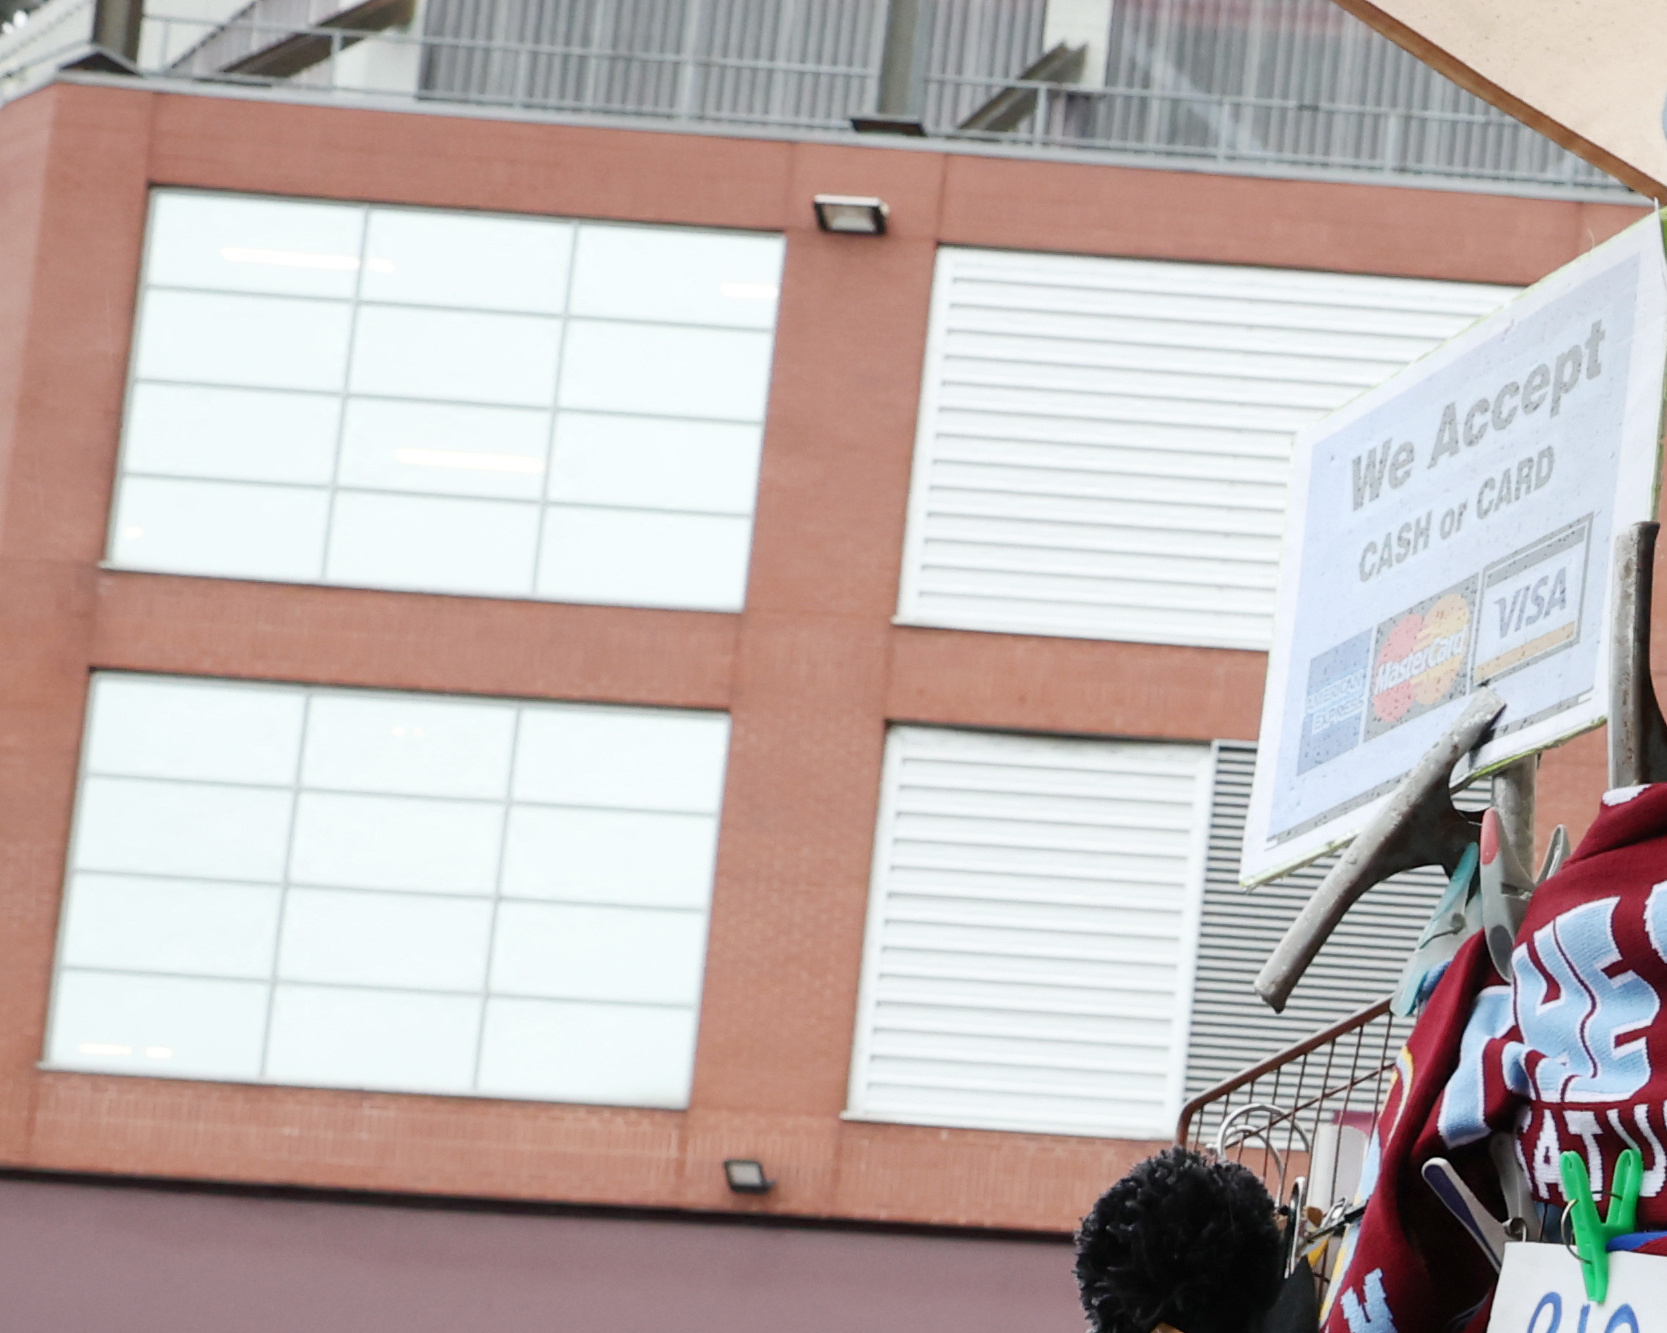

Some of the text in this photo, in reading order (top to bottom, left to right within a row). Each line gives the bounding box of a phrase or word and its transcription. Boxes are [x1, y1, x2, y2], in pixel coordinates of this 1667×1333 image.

[1352, 318, 1606, 512] We Accept
[1359, 445, 1555, 582] CASH or CARD
[1493, 567, 1567, 640] VISA
[1376, 624, 1468, 695] MasterCard
